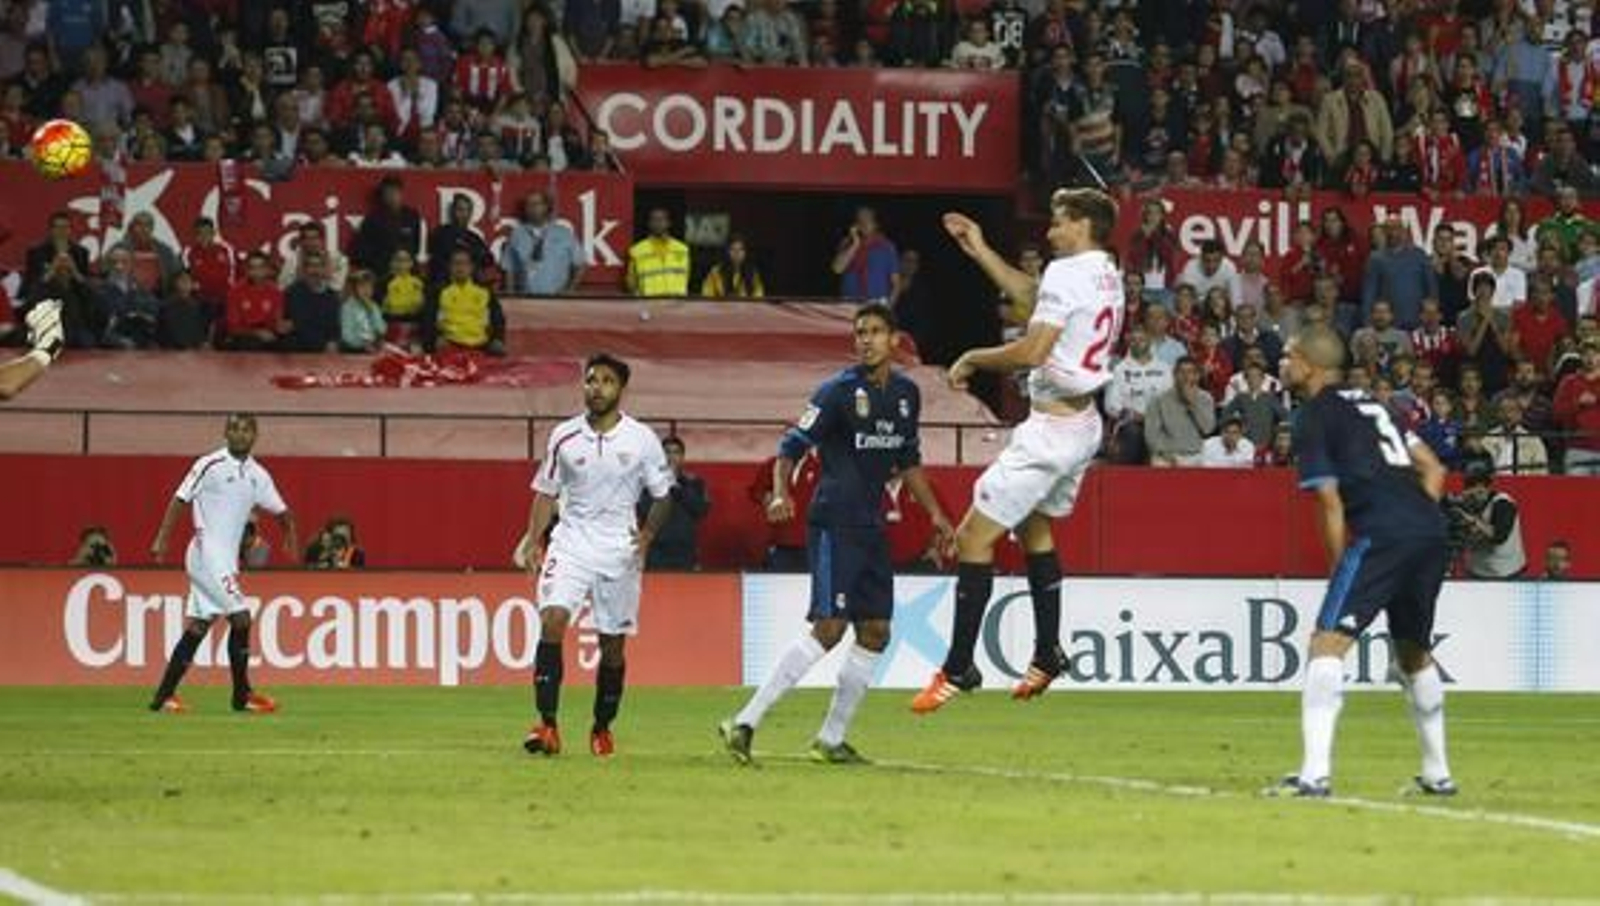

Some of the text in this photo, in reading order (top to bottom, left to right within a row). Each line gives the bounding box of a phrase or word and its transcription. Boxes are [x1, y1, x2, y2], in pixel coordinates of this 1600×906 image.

[598, 92, 988, 157] CORDIALITY
[1357, 403, 1412, 467] 3
[64, 573, 542, 686] Crucampo
[982, 590, 1457, 684] CaixaBn
